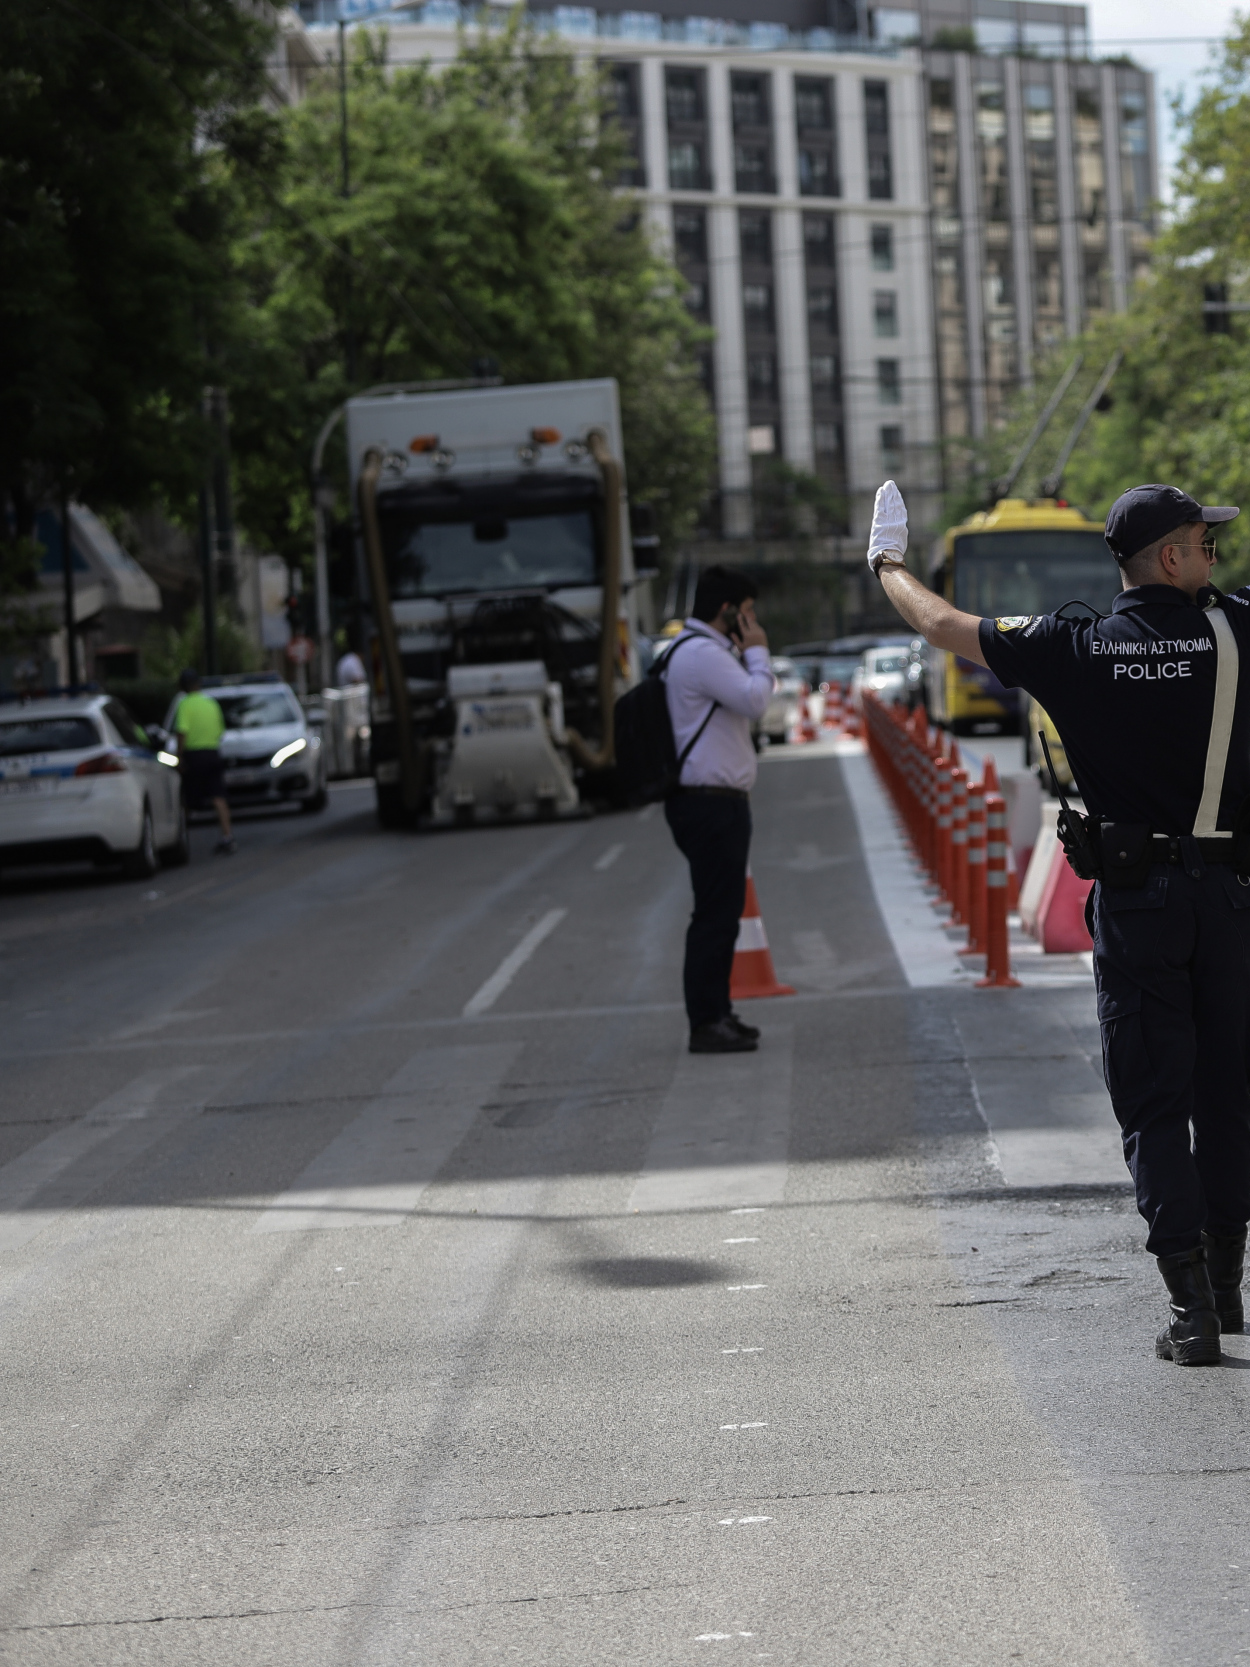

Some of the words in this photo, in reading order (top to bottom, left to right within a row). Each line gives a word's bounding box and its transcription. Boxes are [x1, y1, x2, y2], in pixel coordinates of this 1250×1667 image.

[1092, 641, 1147, 655] ΕΛΛΗΝΙΚΗ
[1151, 637, 1213, 655] ΑΣΤΥΝΟΜΙΑ
[1113, 661, 1192, 680] POLICE
